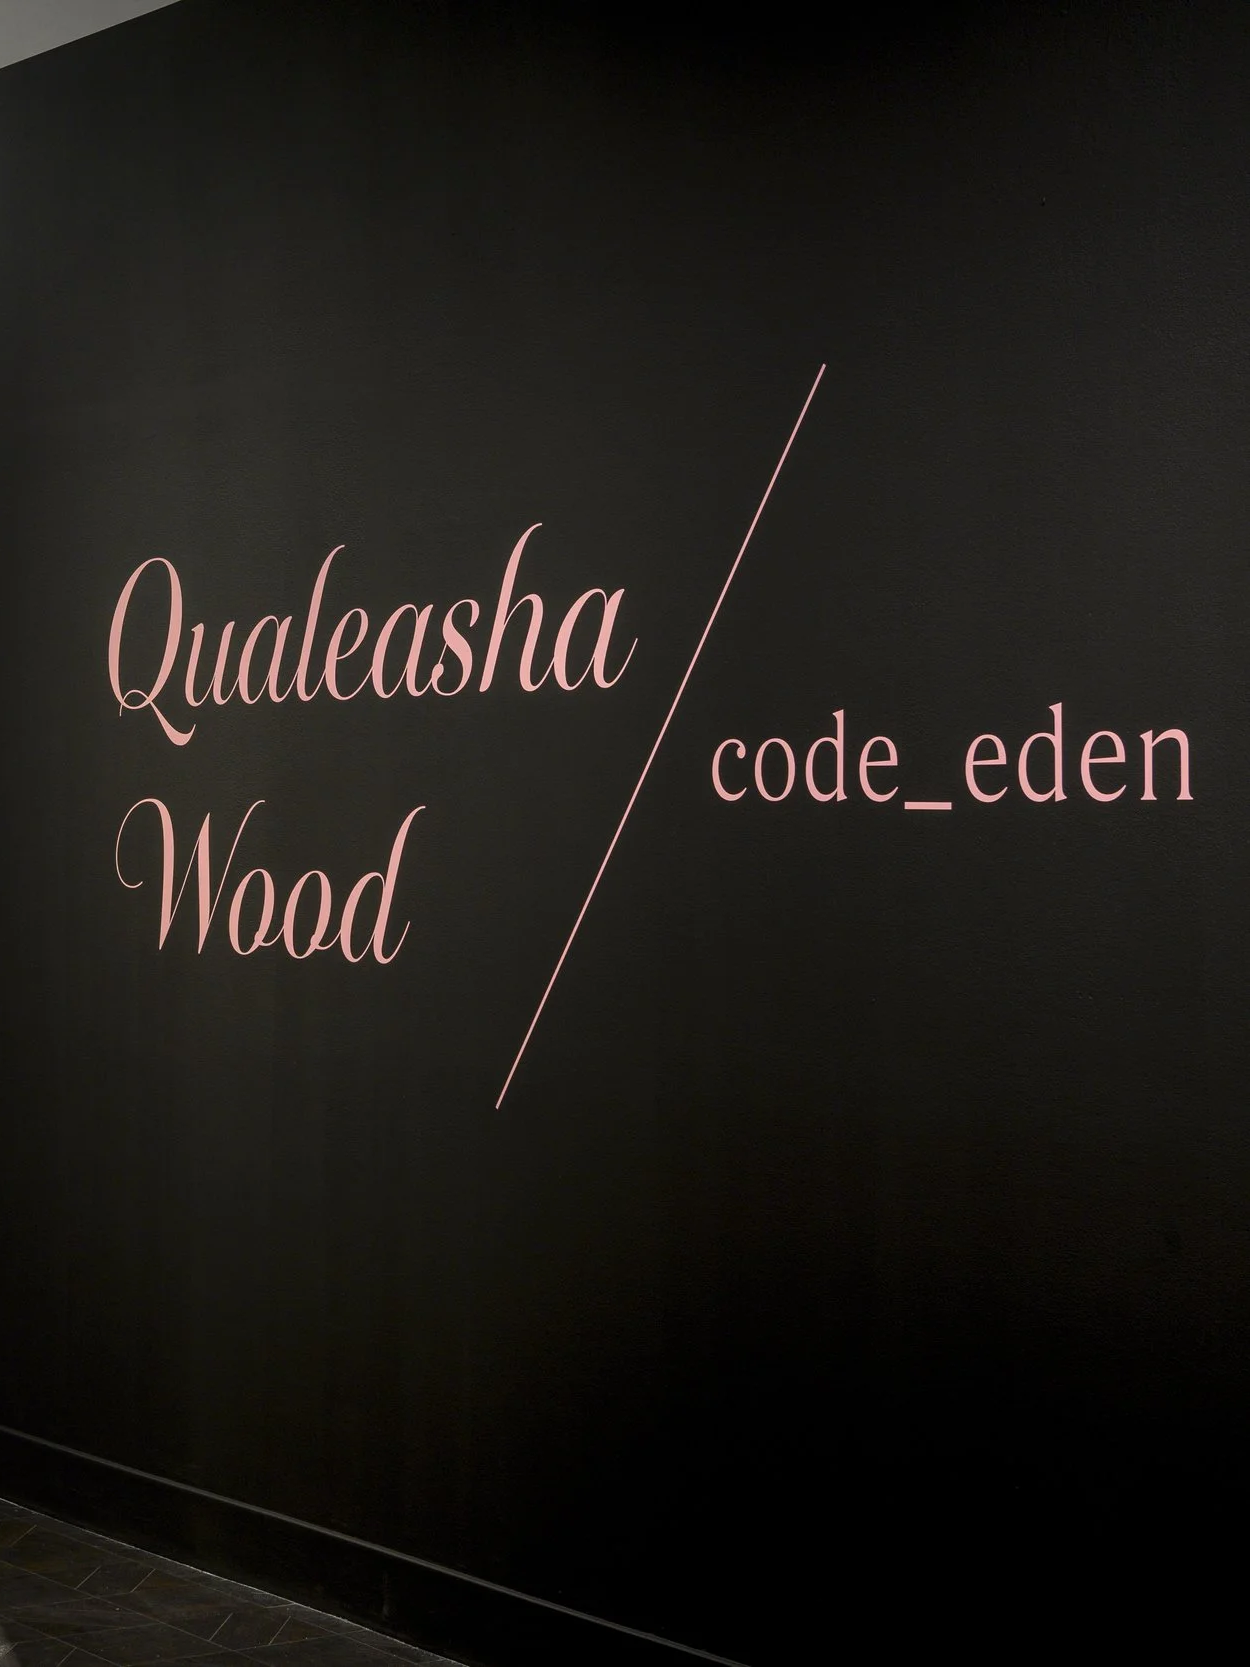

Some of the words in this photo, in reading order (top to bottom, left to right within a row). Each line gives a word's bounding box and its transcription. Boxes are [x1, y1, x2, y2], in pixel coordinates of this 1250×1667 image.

[108, 523, 638, 746] Qualeasha
[712, 702, 1194, 810] code_eden
[116, 798, 426, 964] Wood
